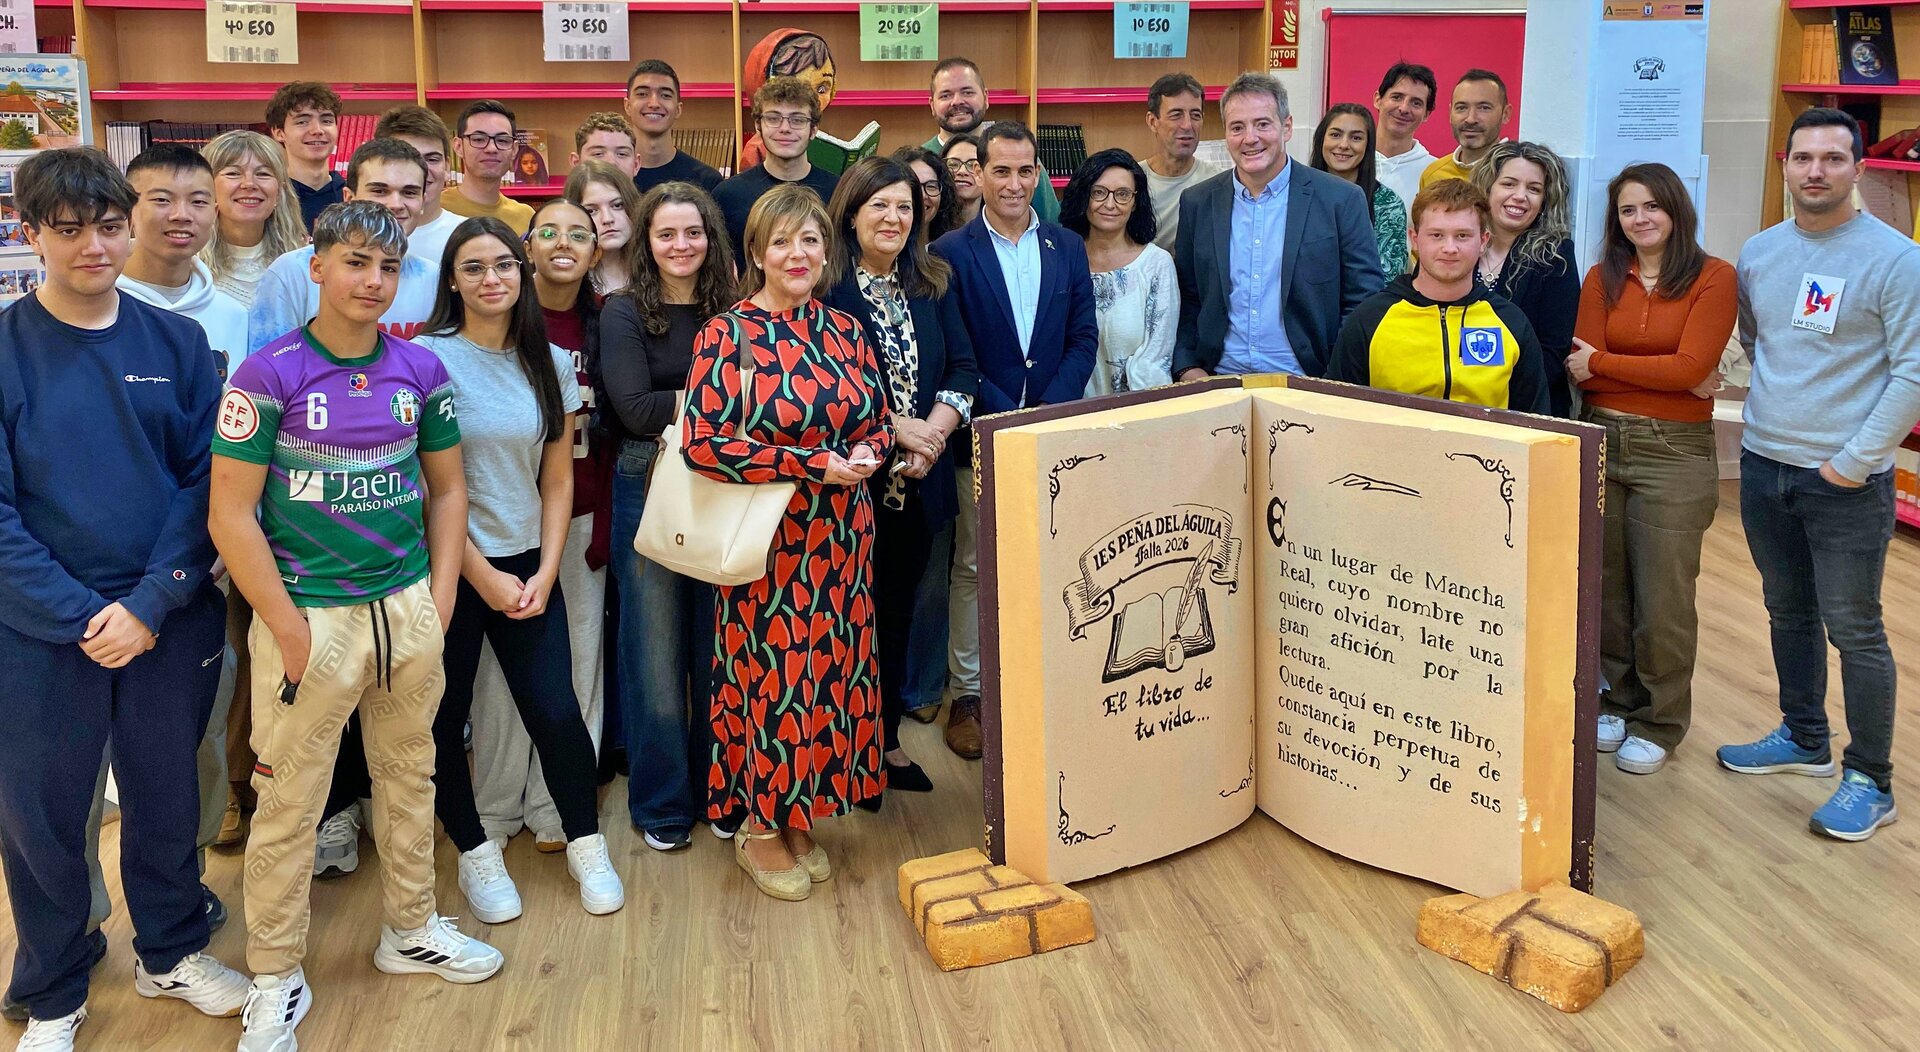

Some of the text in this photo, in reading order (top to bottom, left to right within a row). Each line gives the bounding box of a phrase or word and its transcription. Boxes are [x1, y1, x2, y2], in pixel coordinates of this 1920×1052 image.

[248, 20, 275, 36] ESO
[582, 18, 608, 34] ESO
[897, 20, 921, 34] ESO
[1148, 18, 1170, 32] ESO
[1849, 16, 1881, 31] ATLAS
[31, 65, 56, 73] ÁGUILA
[1793, 318, 1831, 333] LM STUDIO
[124, 374, 171, 384] Champion
[306, 392, 328, 431] 6
[330, 470, 401, 502] Jaén
[331, 489, 419, 514] PARAÍSO INTERIOR
[1093, 510, 1222, 571] IES PEÑA DEL ÁGUILA
[1134, 536, 1189, 568] Falla 2026
[1303, 545, 1323, 562] un
[1331, 548, 1378, 576] lugar
[1390, 564, 1413, 584] de
[1425, 571, 1505, 609] Mancha
[1280, 560, 1504, 636] Real, cuyo nombre no
[1279, 591, 1504, 667] quiero olvidar, late una
[1279, 637, 1330, 670] lectura.
[1279, 617, 1503, 695] gran afición por la
[1102, 668, 1213, 717] El libro de
[1134, 704, 1210, 741] tu vida...
[1279, 665, 1502, 758] Quede aquí en este libro,
[1278, 695, 1501, 781] constancia perpetua de
[1277, 742, 1358, 790] historias...
[1277, 721, 1501, 813] su devoción y de sus
